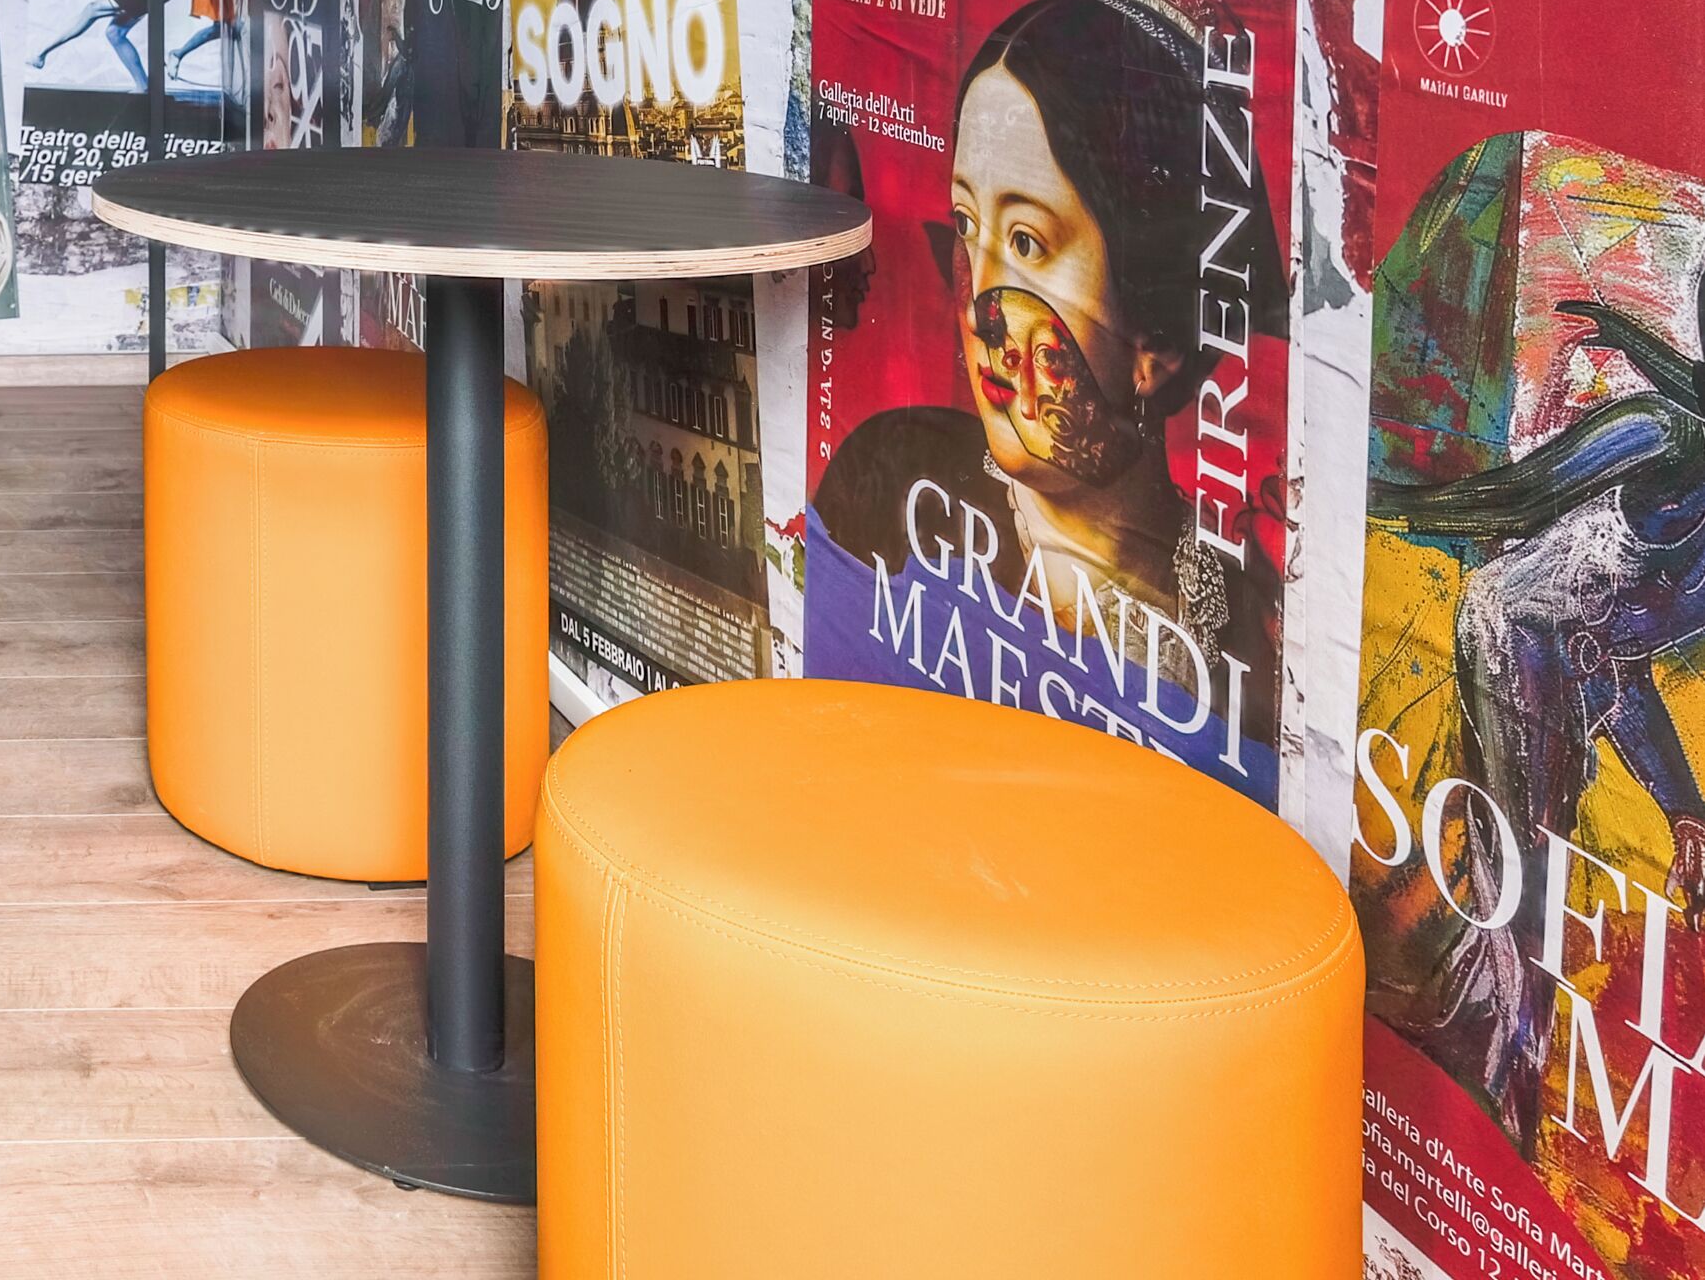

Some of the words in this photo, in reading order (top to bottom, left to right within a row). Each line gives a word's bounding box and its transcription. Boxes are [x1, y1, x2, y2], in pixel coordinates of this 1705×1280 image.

[818, 102, 825, 119] 7
[827, 103, 859, 126] aprile
[869, 116, 879, 133] 12
[882, 121, 945, 153] settembre
[819, 80, 863, 109] Galleria
[865, 92, 914, 124] dell'Arti
[19, 146, 66, 166] Fiori
[72, 148, 104, 170] 20,
[21, 126, 87, 148] Teatro
[93, 130, 145, 151] della
[1196, 25, 1256, 571] FIRENZE
[560, 612, 581, 642] DAL
[583, 625, 590, 648] 5
[592, 631, 645, 682] FEBBRAIO
[906, 478, 1251, 778] GRANDI
[1381, 1169, 1409, 1206] del
[1414, 1195, 1471, 1257] Corso
[1426, 1137, 1485, 1197] d'Arte
[1490, 1185, 1543, 1245] Sofia
